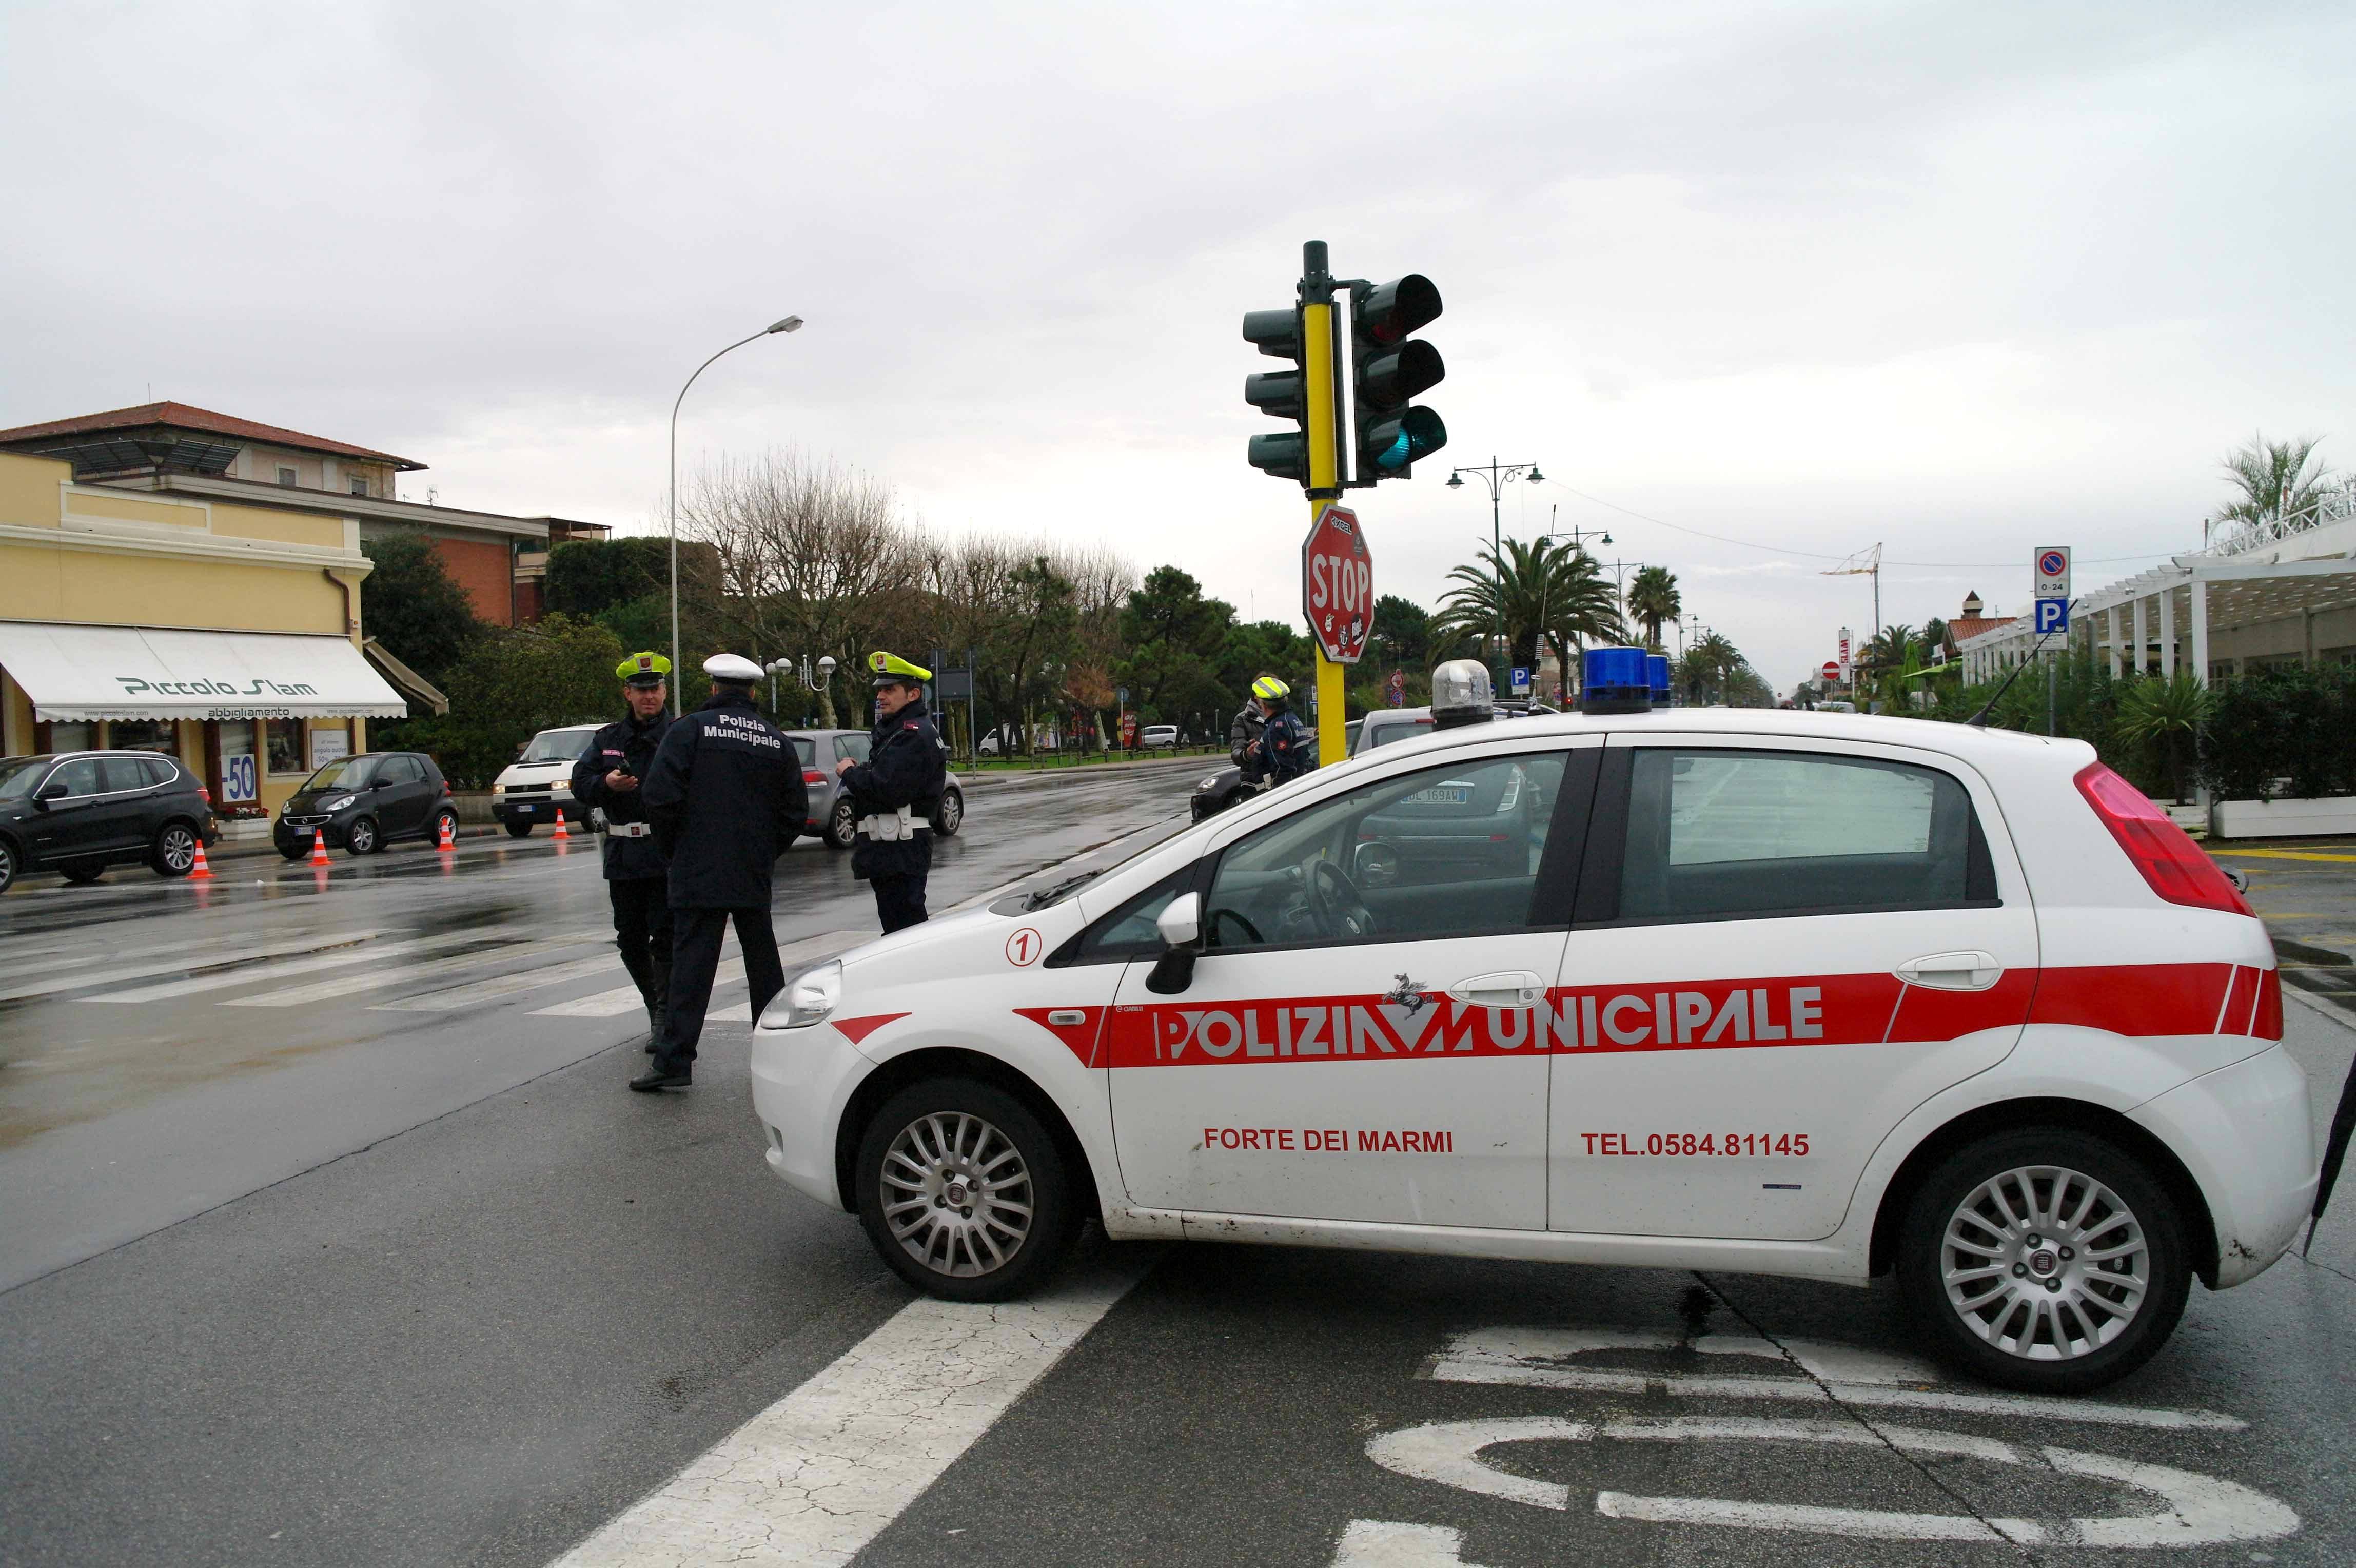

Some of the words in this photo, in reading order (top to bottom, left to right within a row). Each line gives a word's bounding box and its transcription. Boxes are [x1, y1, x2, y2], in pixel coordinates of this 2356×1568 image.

[1312, 553, 1369, 613] STOP
[2041, 603, 2061, 631] P
[1840, 639, 1849, 663] SLAM
[115, 677, 238, 695] Piccolo
[242, 679, 318, 695] Slam
[1515, 670, 1525, 684] P
[208, 707, 290, 718] abbigliamento
[719, 714, 766, 732] Polizia
[704, 726, 781, 749] Municipale
[1015, 933, 1029, 962] 1
[1204, 1128, 1295, 1151] FORTE
[1304, 1130, 1348, 1152] DEI
[1358, 1130, 1454, 1153] MARMI
[1581, 1133, 1809, 1157] TEL.0584.81145
